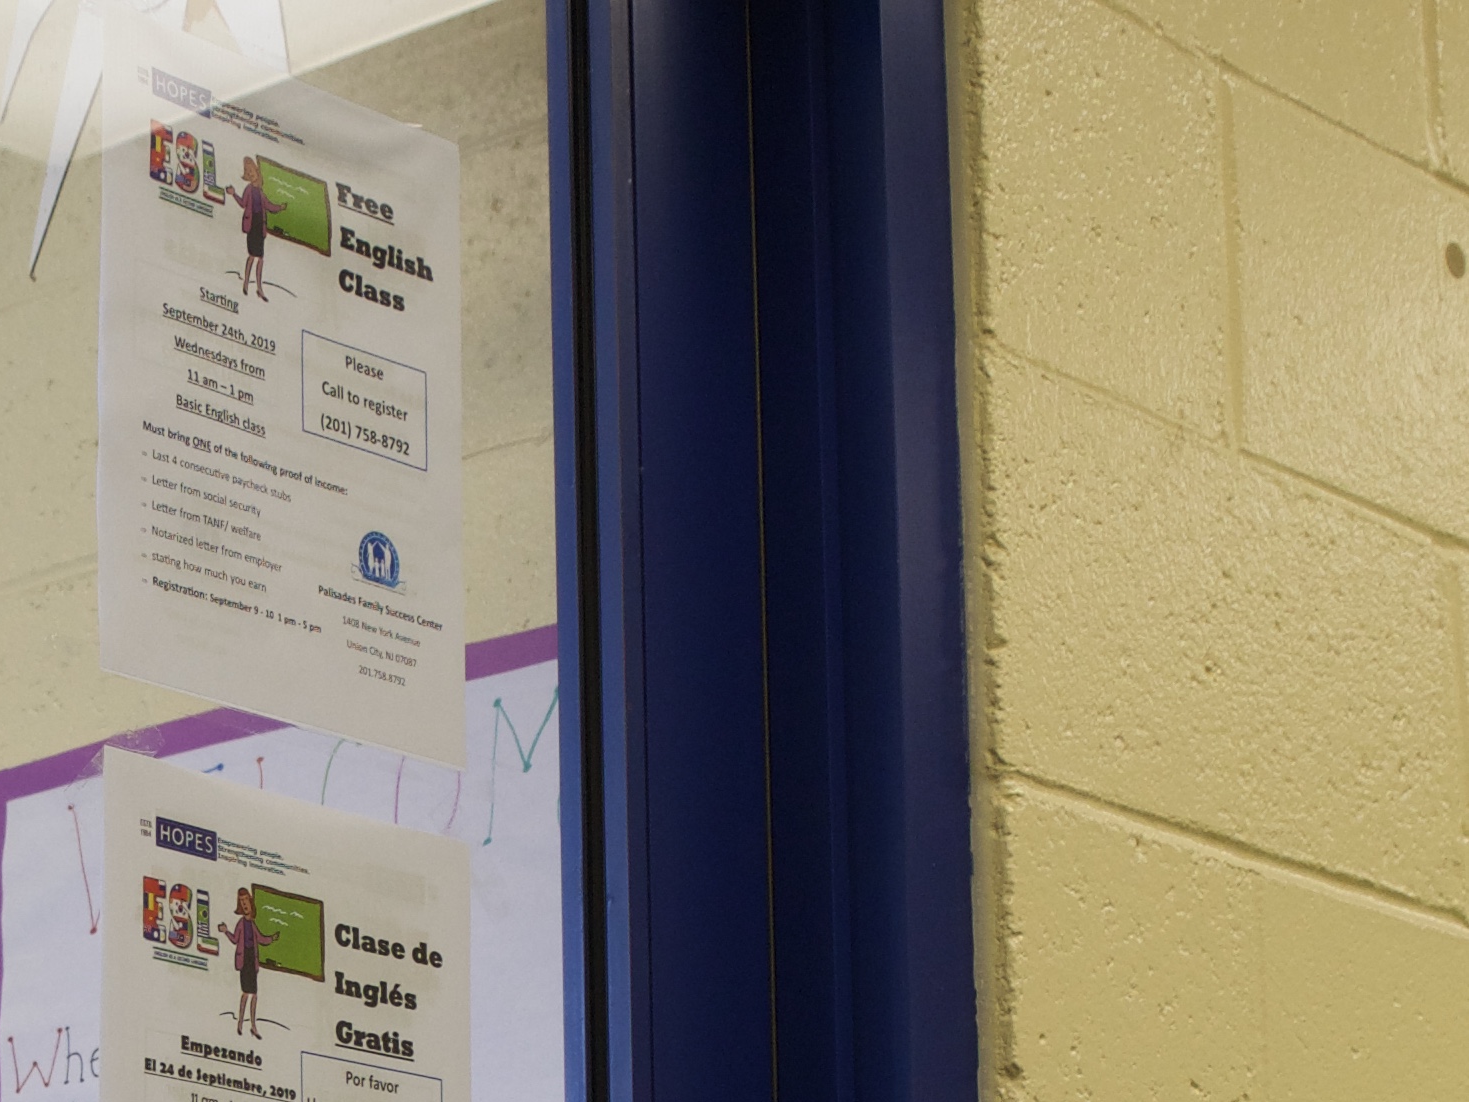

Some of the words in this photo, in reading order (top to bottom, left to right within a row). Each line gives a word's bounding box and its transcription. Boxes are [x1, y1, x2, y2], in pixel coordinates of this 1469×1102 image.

[156, 74, 208, 111] HOPES
[149, 119, 225, 205] ESL
[336, 182, 394, 220] Free
[340, 227, 433, 281] English
[200, 287, 239, 313] Starting
[339, 269, 405, 311] Class
[163, 303, 219, 332] September
[221, 324, 247, 344] 24th,
[251, 334, 276, 352] 2019
[174, 336, 238, 368] Wednesdays
[241, 359, 265, 378] from
[346, 356, 384, 379] Please
[176, 394, 202, 414] Basic
[205, 404, 240, 428] English
[242, 417, 266, 435] class
[322, 382, 343, 399] Call
[347, 391, 359, 404] to
[364, 396, 408, 422] register
[321, 414, 351, 439] (201)
[356, 426, 409, 456] 758-8792
[152, 475, 177, 492] Letter
[180, 484, 201, 499] from
[203, 491, 226, 506] social
[229, 498, 261, 518] security
[159, 825, 212, 853] HOPES
[142, 876, 219, 956] ESL
[335, 924, 405, 959] Clase
[412, 942, 442, 968] de
[335, 972, 417, 1010] Inglés
[181, 1035, 262, 1067] Empezando
[336, 1021, 414, 1057] Gratis
[145, 1058, 156, 1071] El
[159, 1061, 174, 1076] 24
[178, 1066, 193, 1079] de
[196, 1069, 266, 1097] Septiembre,
[270, 1084, 296, 1101] 2019
[346, 1071, 365, 1088] Por
[369, 1076, 399, 1094] favor
